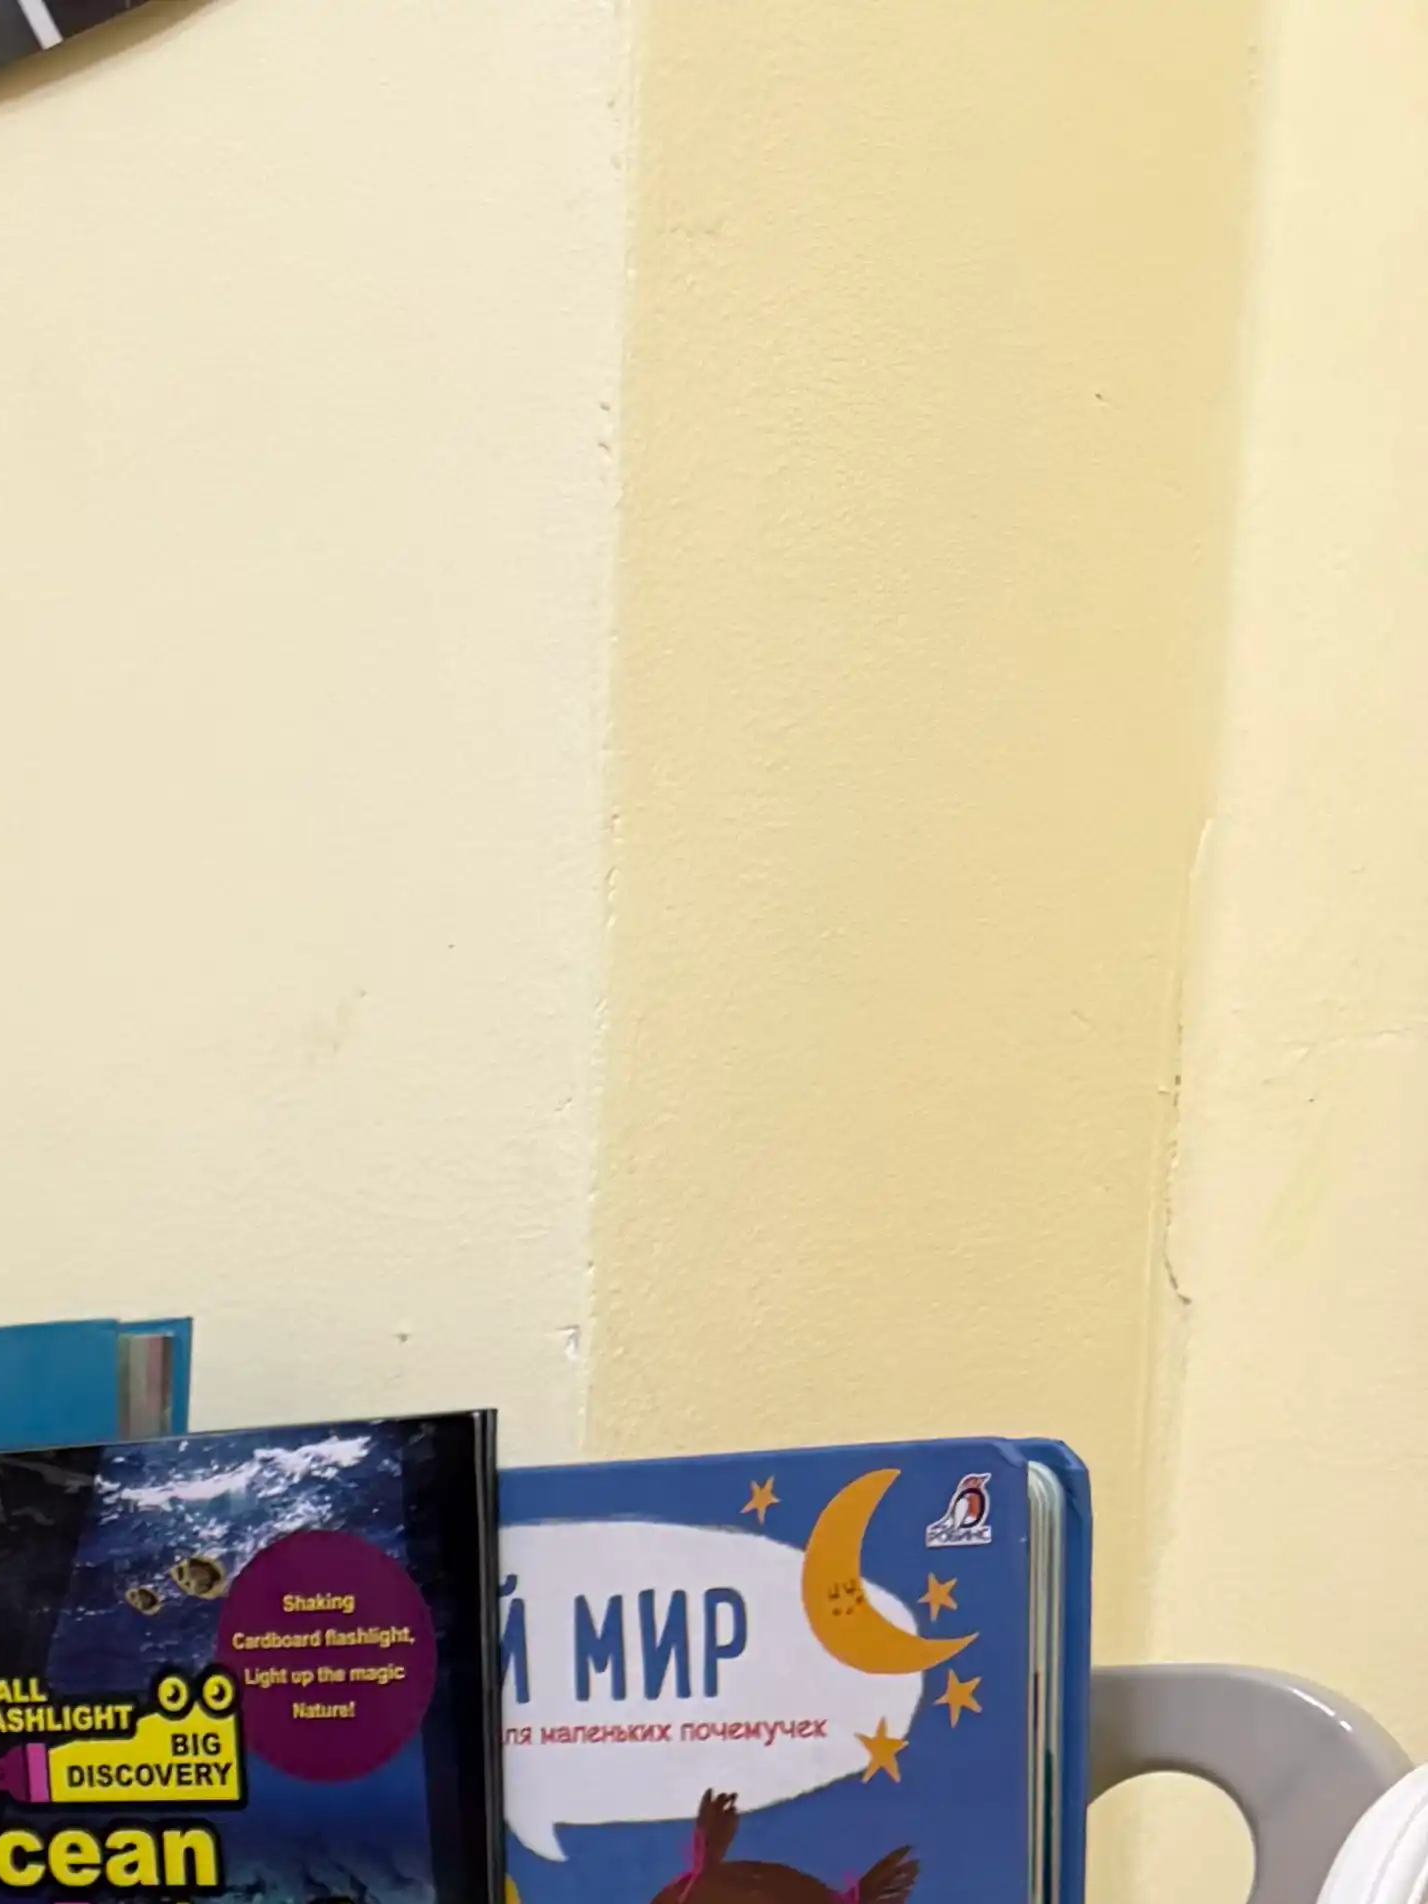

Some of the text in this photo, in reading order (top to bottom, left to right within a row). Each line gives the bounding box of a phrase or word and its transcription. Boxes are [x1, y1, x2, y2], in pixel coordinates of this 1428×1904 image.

[282, 1593, 355, 1614] Shaking
[232, 1626, 415, 1650] Cardboard flashlight,
[574, 1587, 747, 1701] МИР
[244, 1664, 405, 1688] Light up the magic
[293, 1701, 355, 1718] Nature!
[502, 1718, 828, 1746] ля маленьких почемучек
[171, 1733, 221, 1756] BIG
[67, 1762, 232, 1788] DISCOVERY
